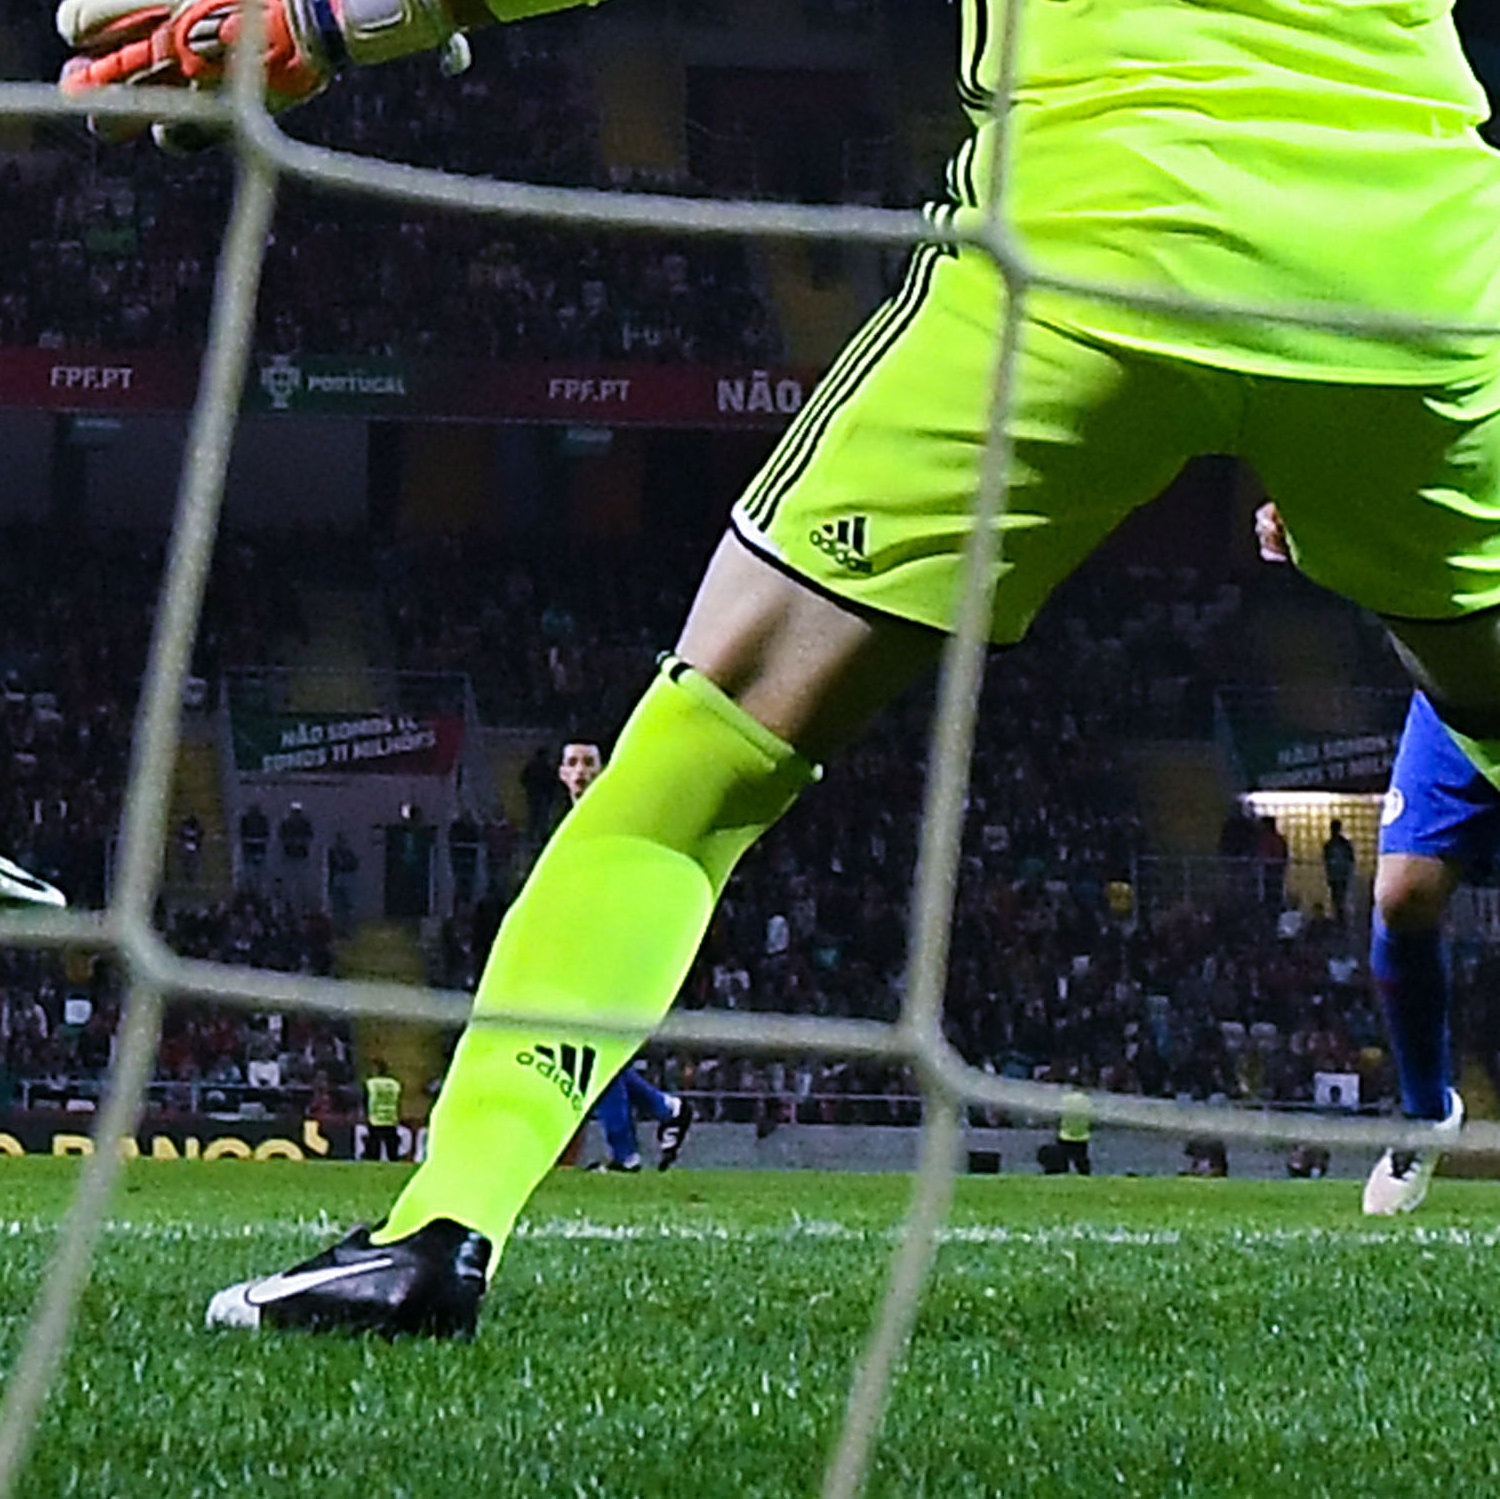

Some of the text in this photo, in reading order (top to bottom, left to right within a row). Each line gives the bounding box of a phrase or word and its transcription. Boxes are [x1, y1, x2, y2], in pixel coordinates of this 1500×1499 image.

[49, 365, 135, 390] FPF.PT
[307, 375, 406, 395] PORTUGAL
[547, 377, 632, 403] FPF.PT
[716, 369, 804, 413] NÃO
[514, 1051, 584, 1113] adida
